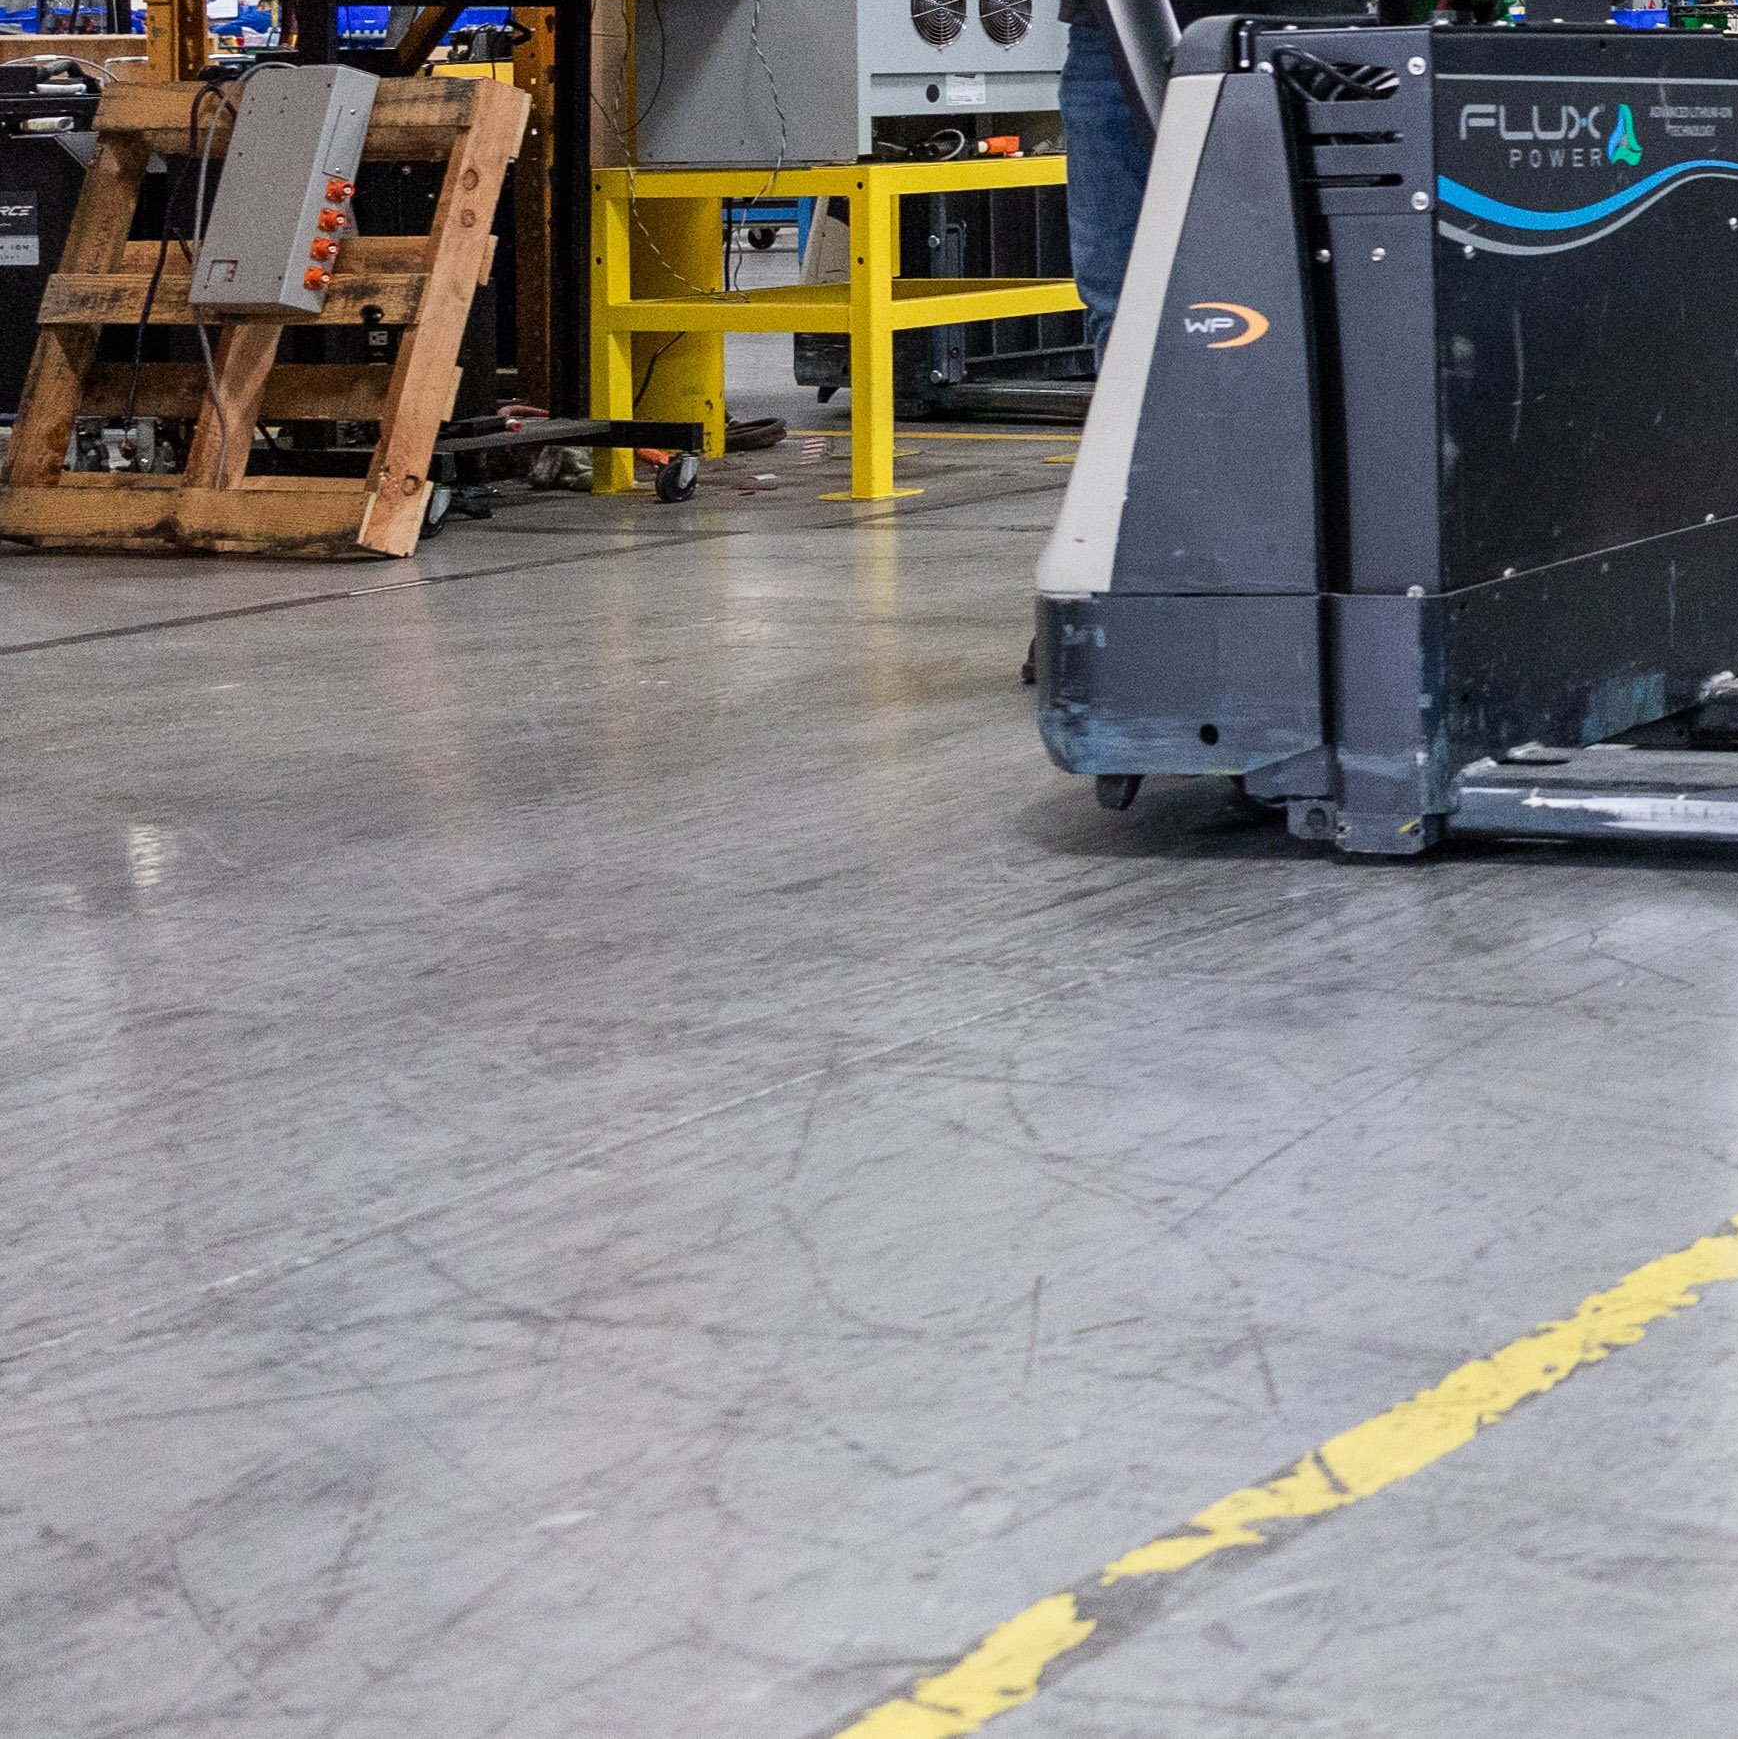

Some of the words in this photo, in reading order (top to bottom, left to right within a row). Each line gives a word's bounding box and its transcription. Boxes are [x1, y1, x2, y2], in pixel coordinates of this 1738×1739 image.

[1459, 103, 1605, 141] FLUX
[1508, 147, 1604, 169] POWER
[1184, 317, 1235, 333] WP
